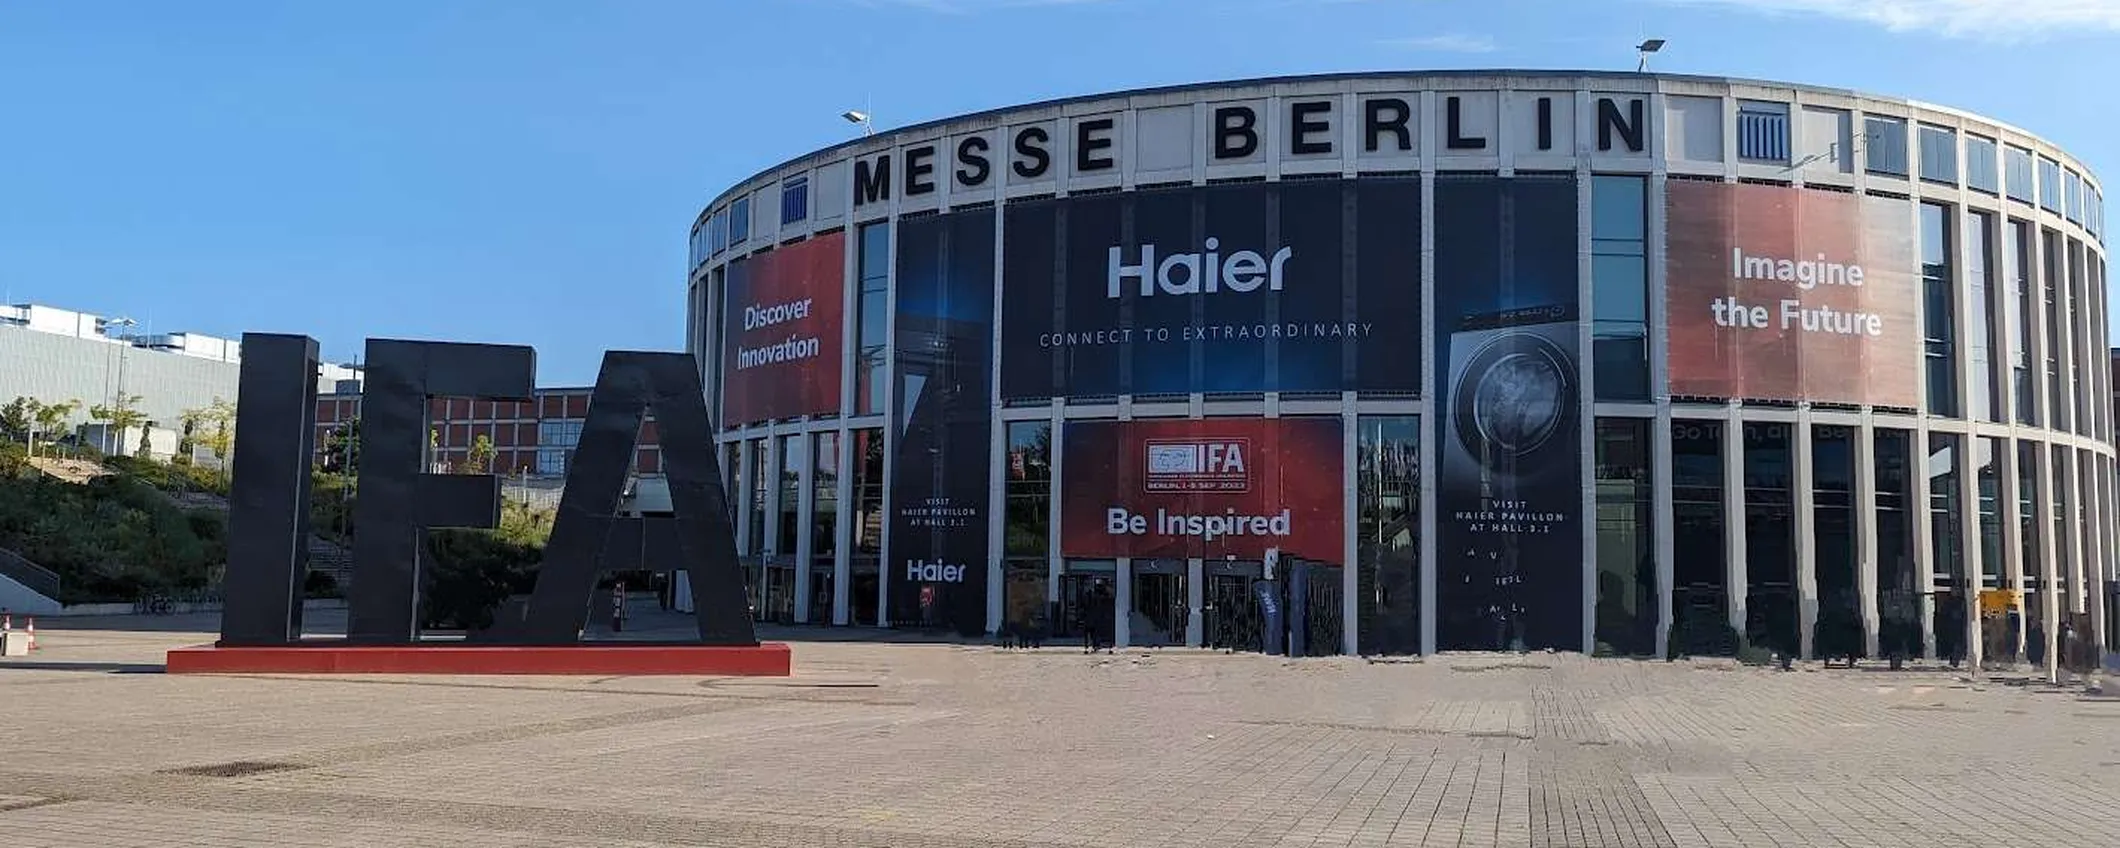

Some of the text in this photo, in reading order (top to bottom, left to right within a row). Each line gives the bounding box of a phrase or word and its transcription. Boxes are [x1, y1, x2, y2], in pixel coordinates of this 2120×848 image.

[853, 96, 1644, 206] MESSE BERLIN
[1107, 237, 1292, 298] Haier
[1733, 247, 1864, 290] Imagine
[744, 298, 813, 332] Discover
[1711, 296, 1883, 337] the Future
[1039, 322, 1373, 348] CONNECT TO EXTRAORDINARY
[737, 333, 820, 371] Innovation
[1198, 442, 1246, 473] IFA
[218, 332, 758, 646] IFA
[925, 498, 950, 506] VISIT
[1492, 500, 1527, 509] VISIT
[901, 508, 928, 517] HAIER
[1107, 507, 1292, 542] Be Inspired
[1455, 511, 1564, 522] HAIER PAVILLON
[1469, 523, 1485, 533] AT
[1491, 523, 1524, 533] HALL
[906, 558, 967, 583] Haier
